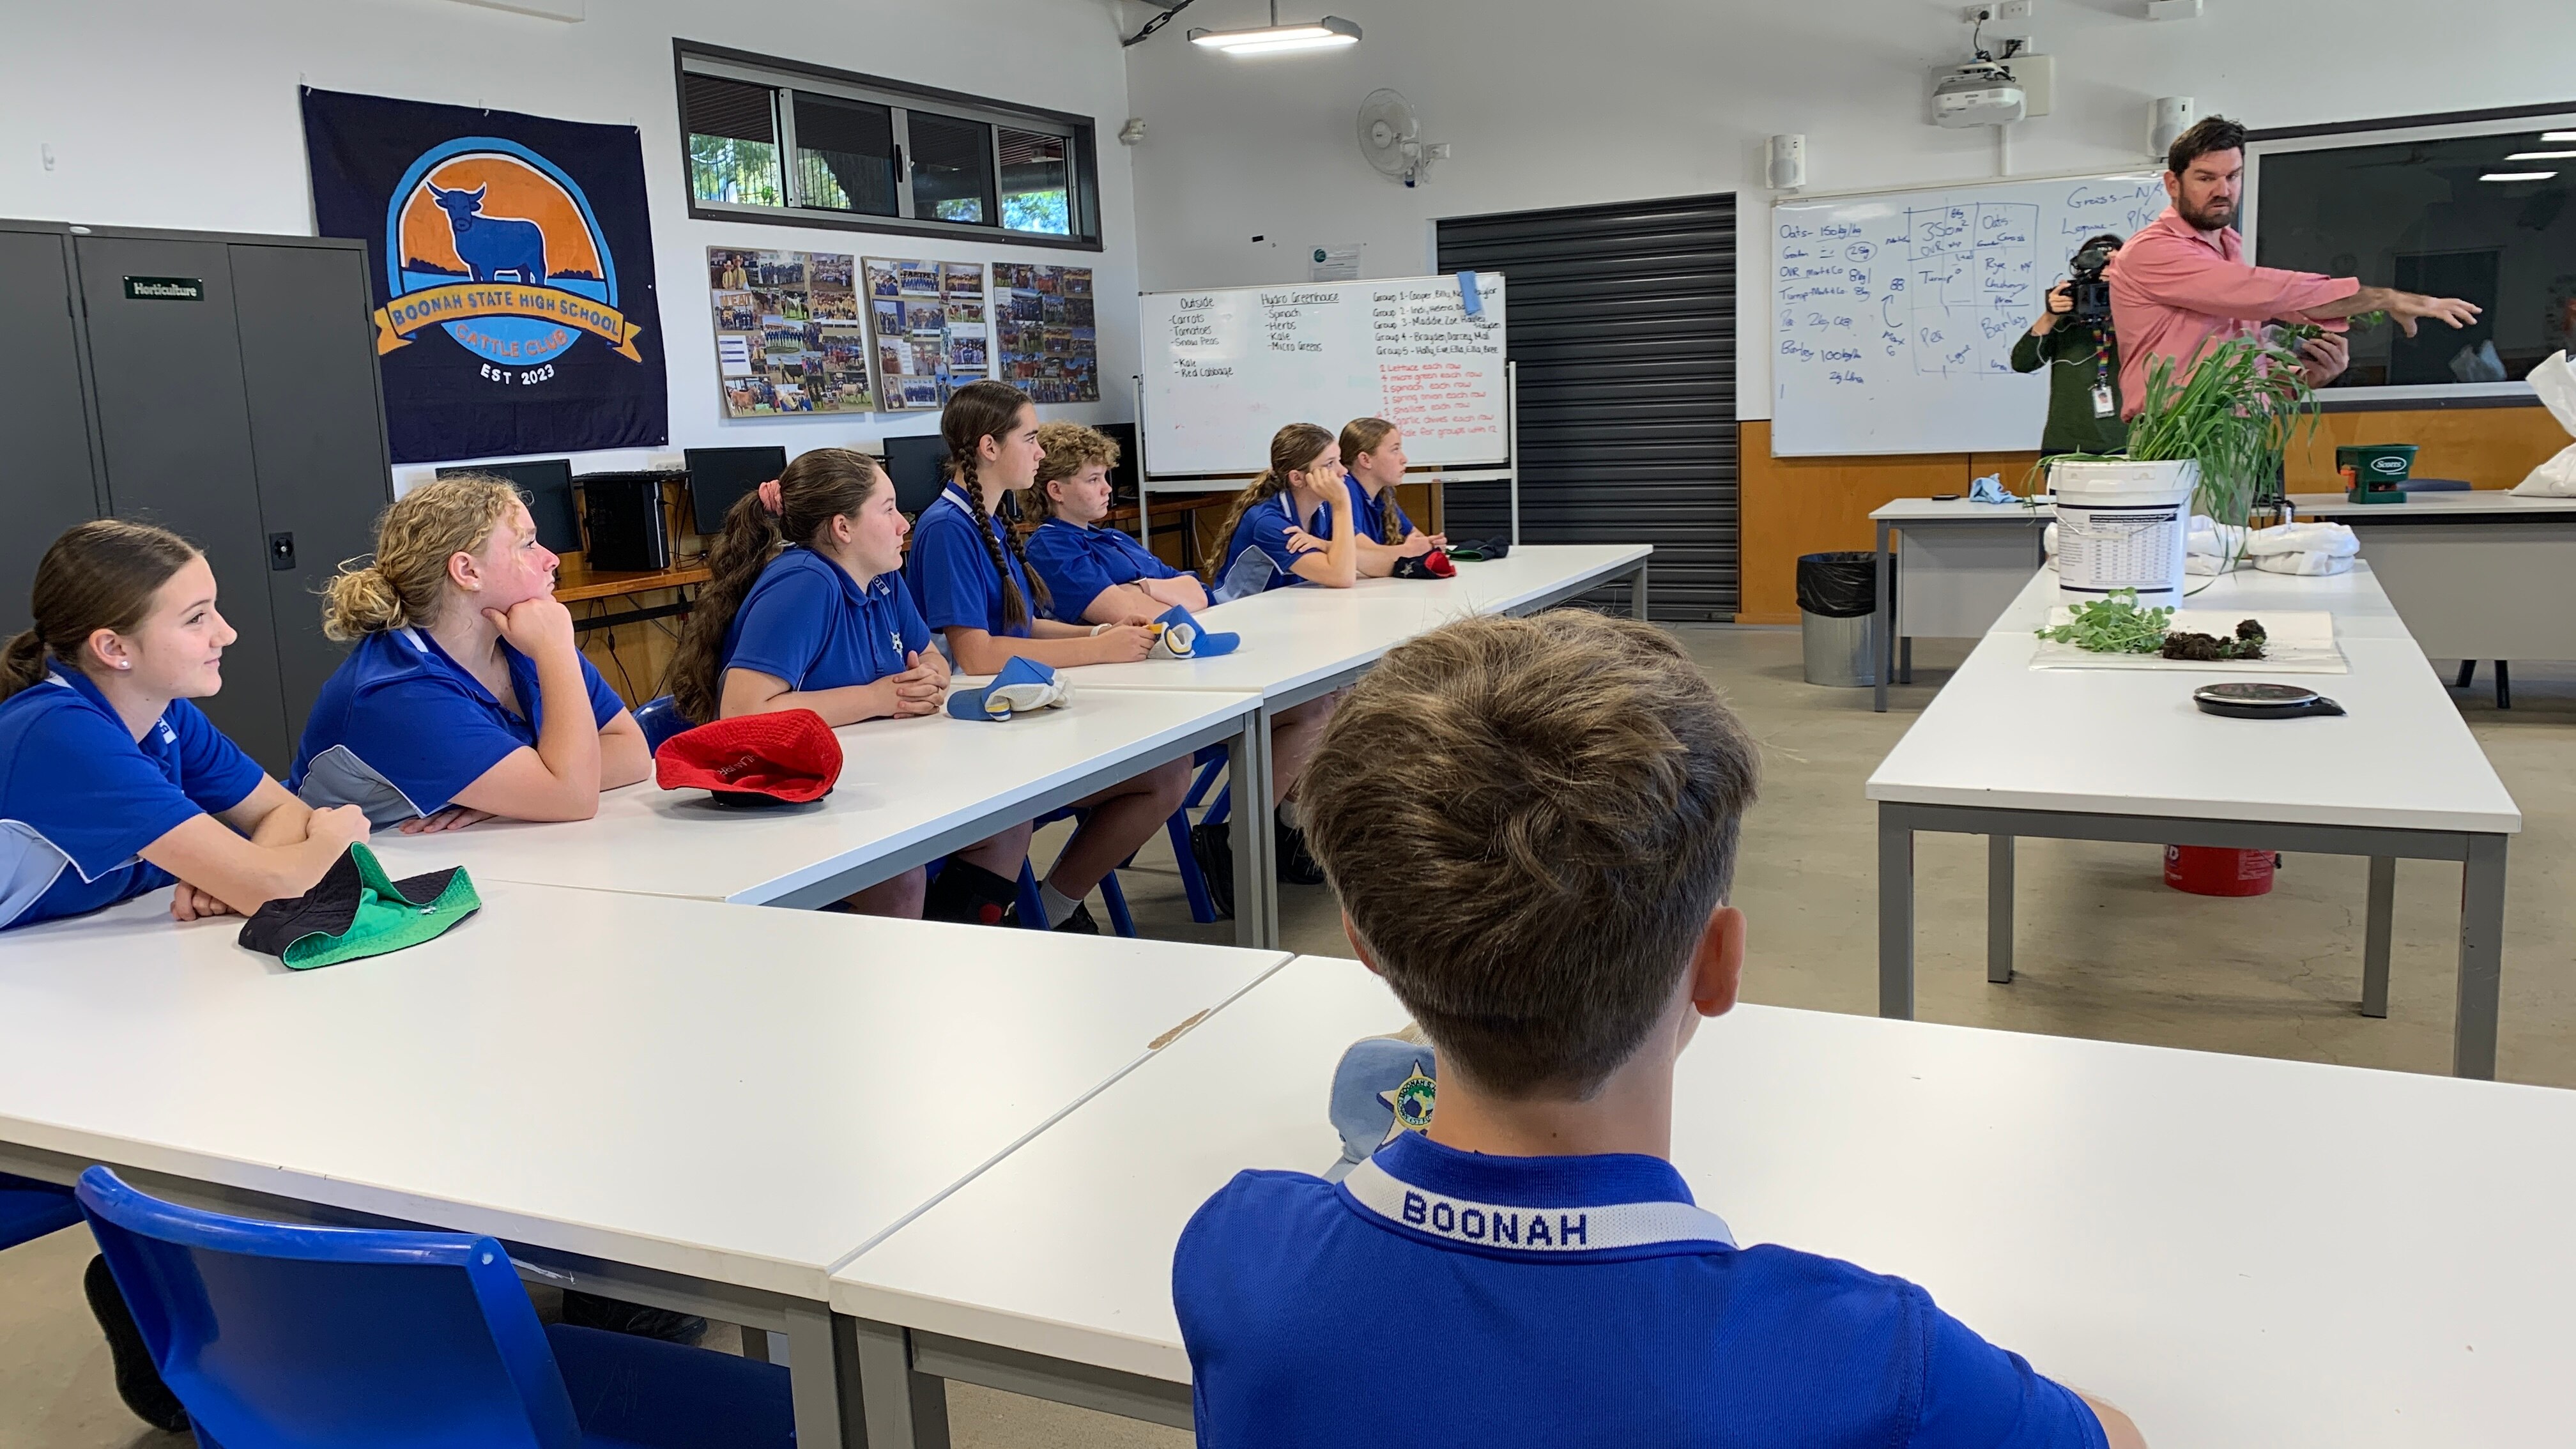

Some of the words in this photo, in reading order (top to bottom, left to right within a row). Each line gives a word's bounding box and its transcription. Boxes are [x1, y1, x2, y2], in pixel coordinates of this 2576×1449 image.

[134, 282, 197, 297] Horticulture
[1181, 296, 1215, 309] Outside
[1261, 293, 1288, 308] Hydro
[1291, 292, 1340, 303] Greenhouse
[392, 295, 463, 326] BOONAH
[468, 291, 513, 308] STATE
[519, 293, 555, 310] HIGH
[560, 300, 618, 337] SCHOOL
[1982, 312, 2028, 339] Barley
[456, 324, 520, 357] CATTLE
[526, 329, 568, 355] CLUB
[1200, 337, 1220, 345] Peas
[1298, 342, 1323, 351] Greens
[480, 363, 512, 385] EST
[521, 364, 555, 385] 2023
[1199, 367, 1234, 378] Cabbage
[1414, 373, 1438, 384] green
[1399, 1079, 1425, 1100] BOONAH
[1403, 1191, 1586, 1246] BOONAH
